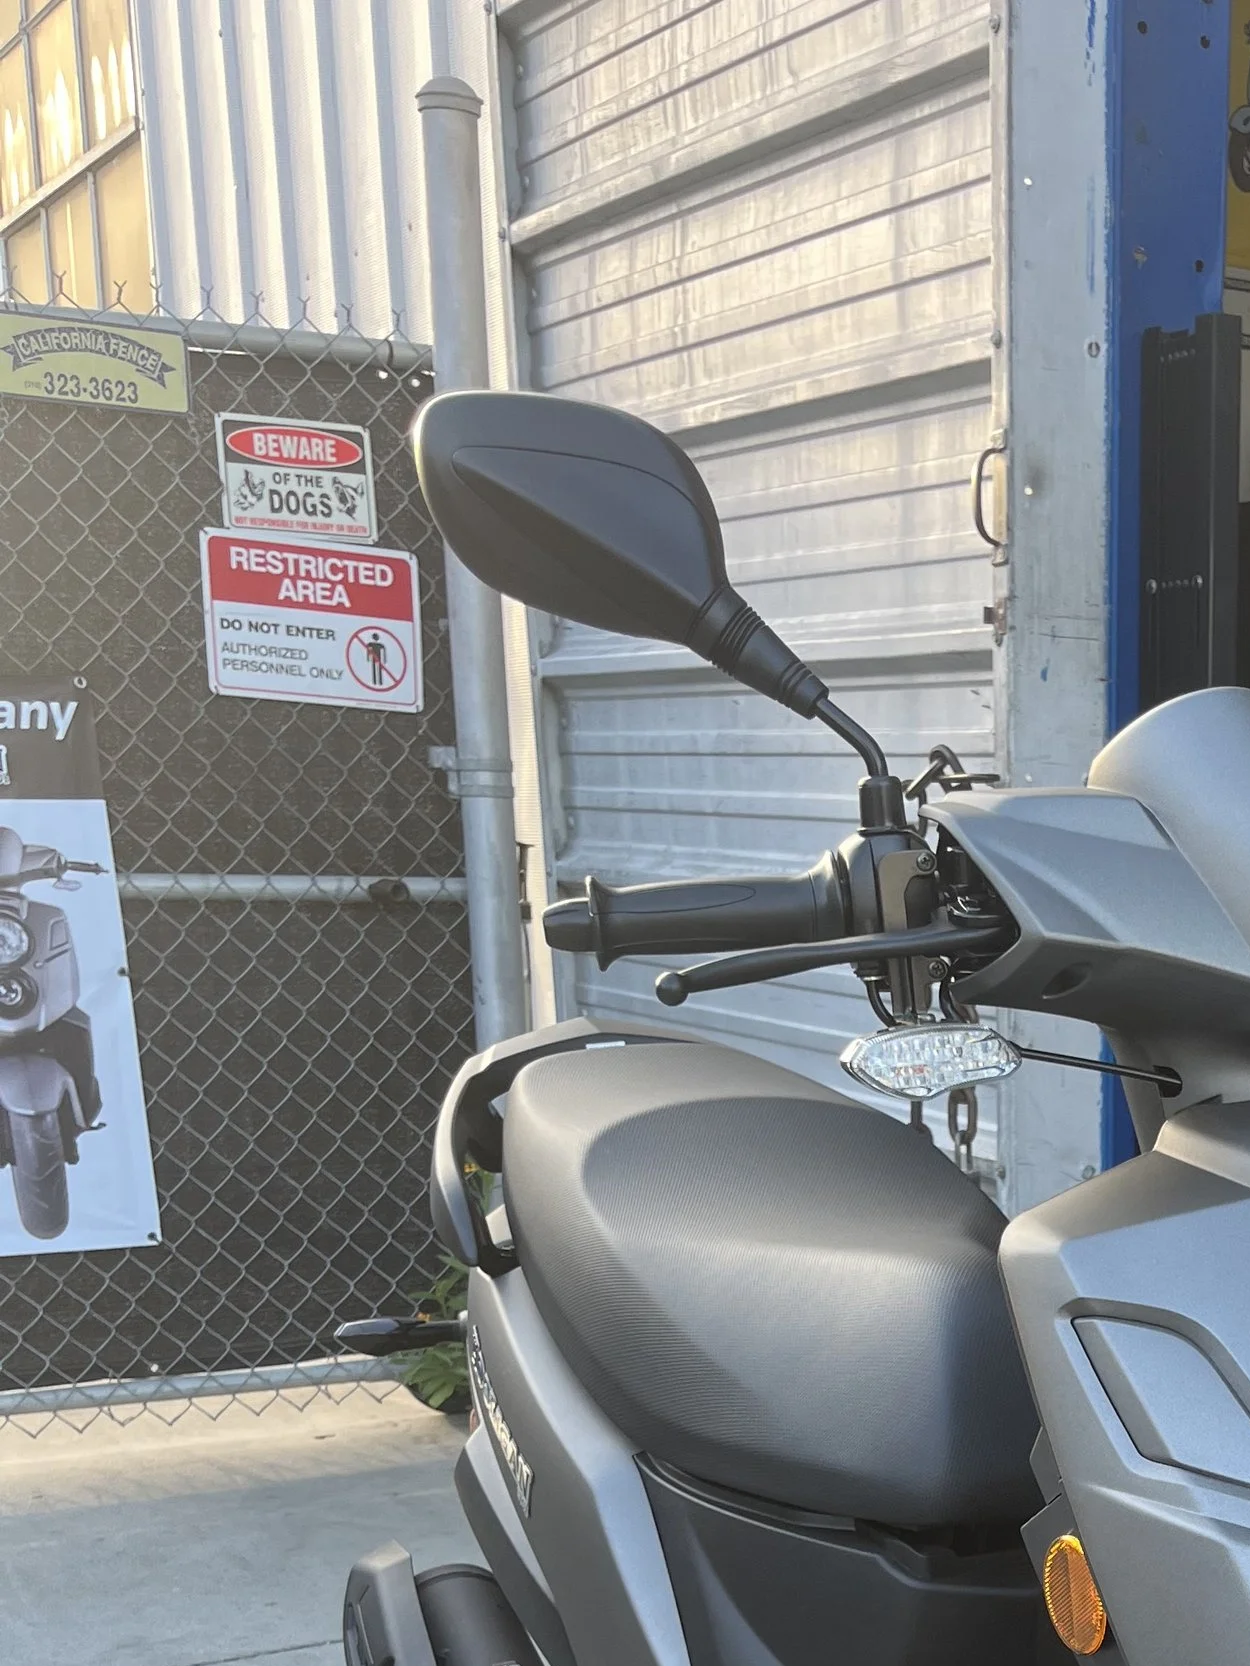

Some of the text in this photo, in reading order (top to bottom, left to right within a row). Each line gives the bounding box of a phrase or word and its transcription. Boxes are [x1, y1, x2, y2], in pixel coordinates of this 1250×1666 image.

[18, 329, 159, 372] CALIFORNIA FENCE
[252, 432, 338, 463] BEWARE
[272, 472, 324, 488] OF THE
[268, 489, 333, 518] DOGS
[229, 546, 394, 587] RESTRICTED
[278, 578, 352, 608] AREA
[220, 617, 337, 641] DO NOT ENTER
[221, 641, 309, 661] AUTHORIZED
[222, 658, 344, 680] PERSONNEL ONLY
